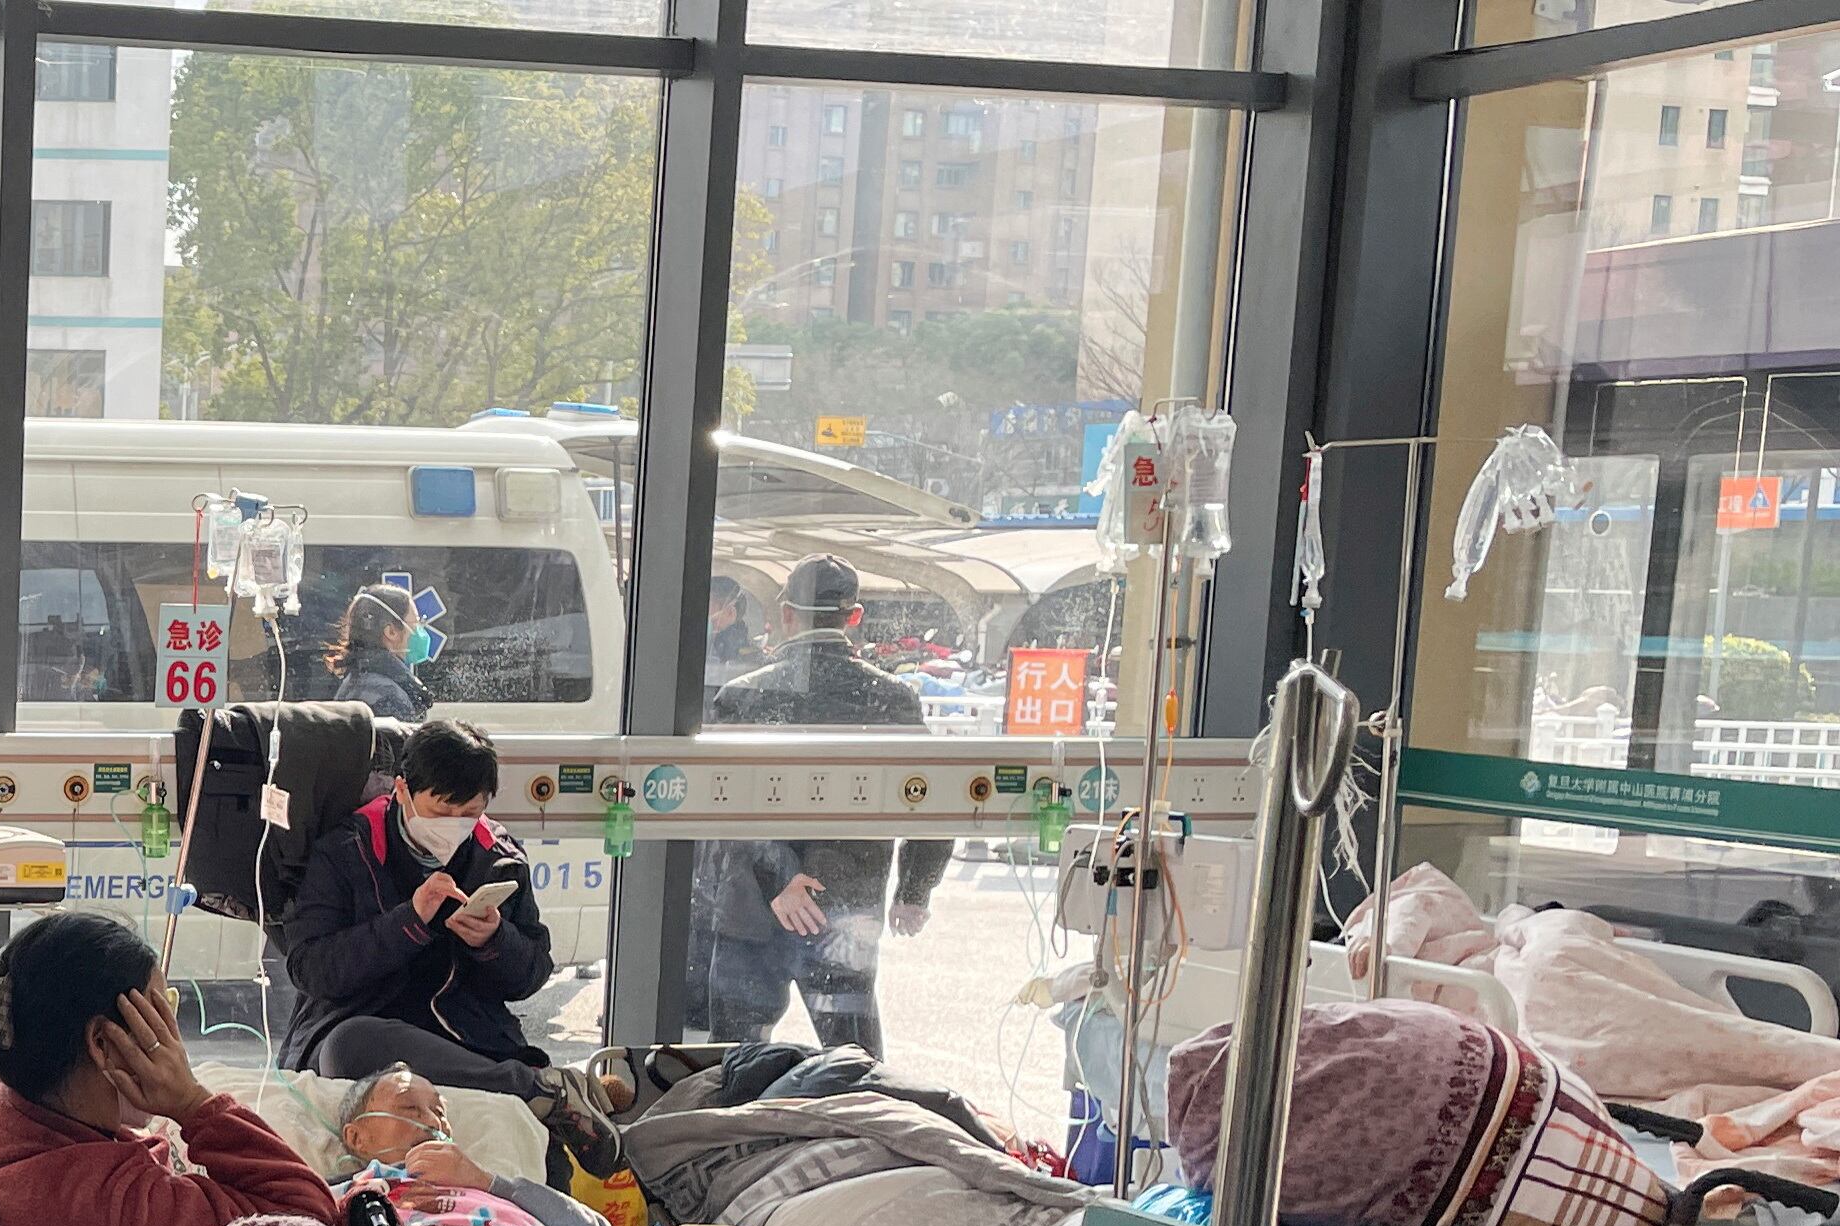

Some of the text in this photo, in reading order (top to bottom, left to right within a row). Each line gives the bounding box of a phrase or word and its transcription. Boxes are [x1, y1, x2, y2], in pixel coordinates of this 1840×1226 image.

[166, 619, 223, 652] 急诊
[166, 660, 217, 703] 66
[1017, 661, 1079, 690] 行人
[1014, 696, 1075, 725] 出口
[645, 777, 687, 801] 20床
[66, 875, 174, 900] EMERG
[532, 861, 603, 890] 015
